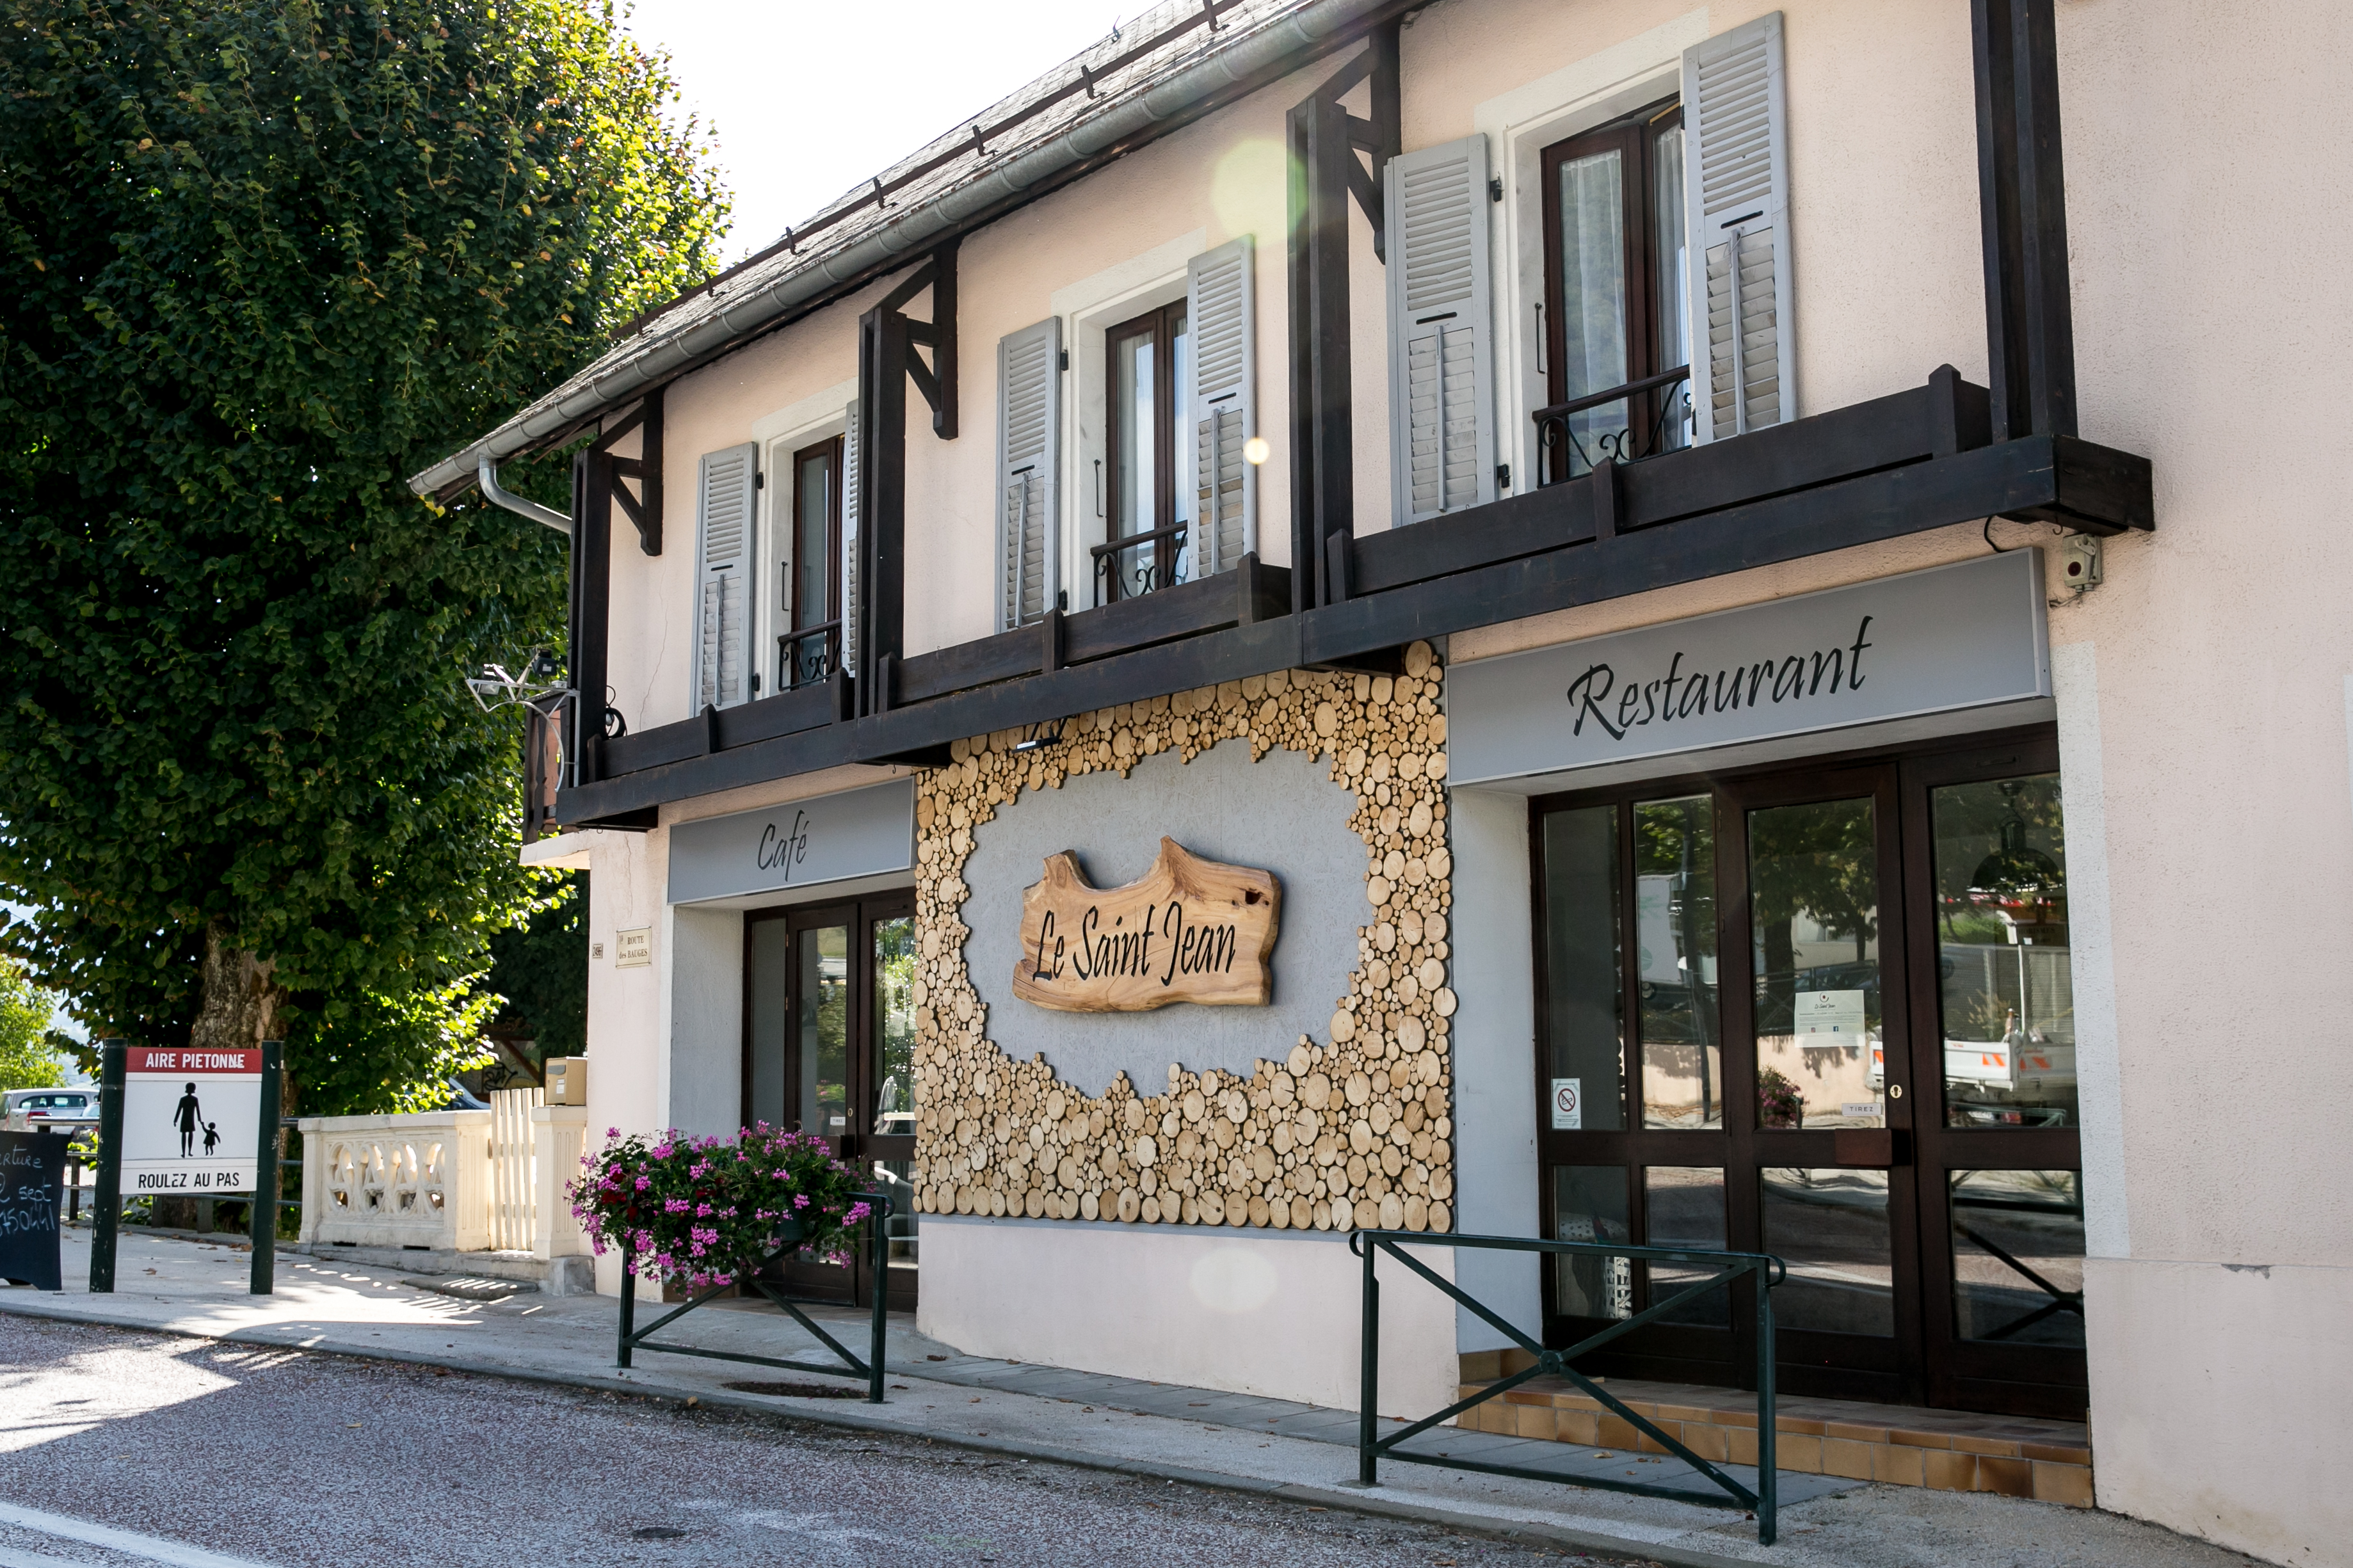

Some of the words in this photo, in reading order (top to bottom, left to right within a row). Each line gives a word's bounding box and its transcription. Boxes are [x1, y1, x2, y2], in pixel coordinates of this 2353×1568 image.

[1567, 615, 1874, 741] Restaurant
[757, 809, 810, 883] Café
[627, 935, 645, 945] ROUTE
[1032, 909, 1065, 982] Le
[1073, 904, 1156, 981] Saint
[1160, 900, 1236, 987] Jean
[618, 951, 627, 959] des
[627, 948, 648, 958] BAUGES
[145, 1053, 177, 1068] AIRE
[182, 1053, 245, 1069] PIETONNE
[138, 1173, 187, 1188] ROULEZ
[193, 1172, 211, 1187] AU
[216, 1172, 239, 1187] PAS
[19, 1176, 52, 1211] sept
